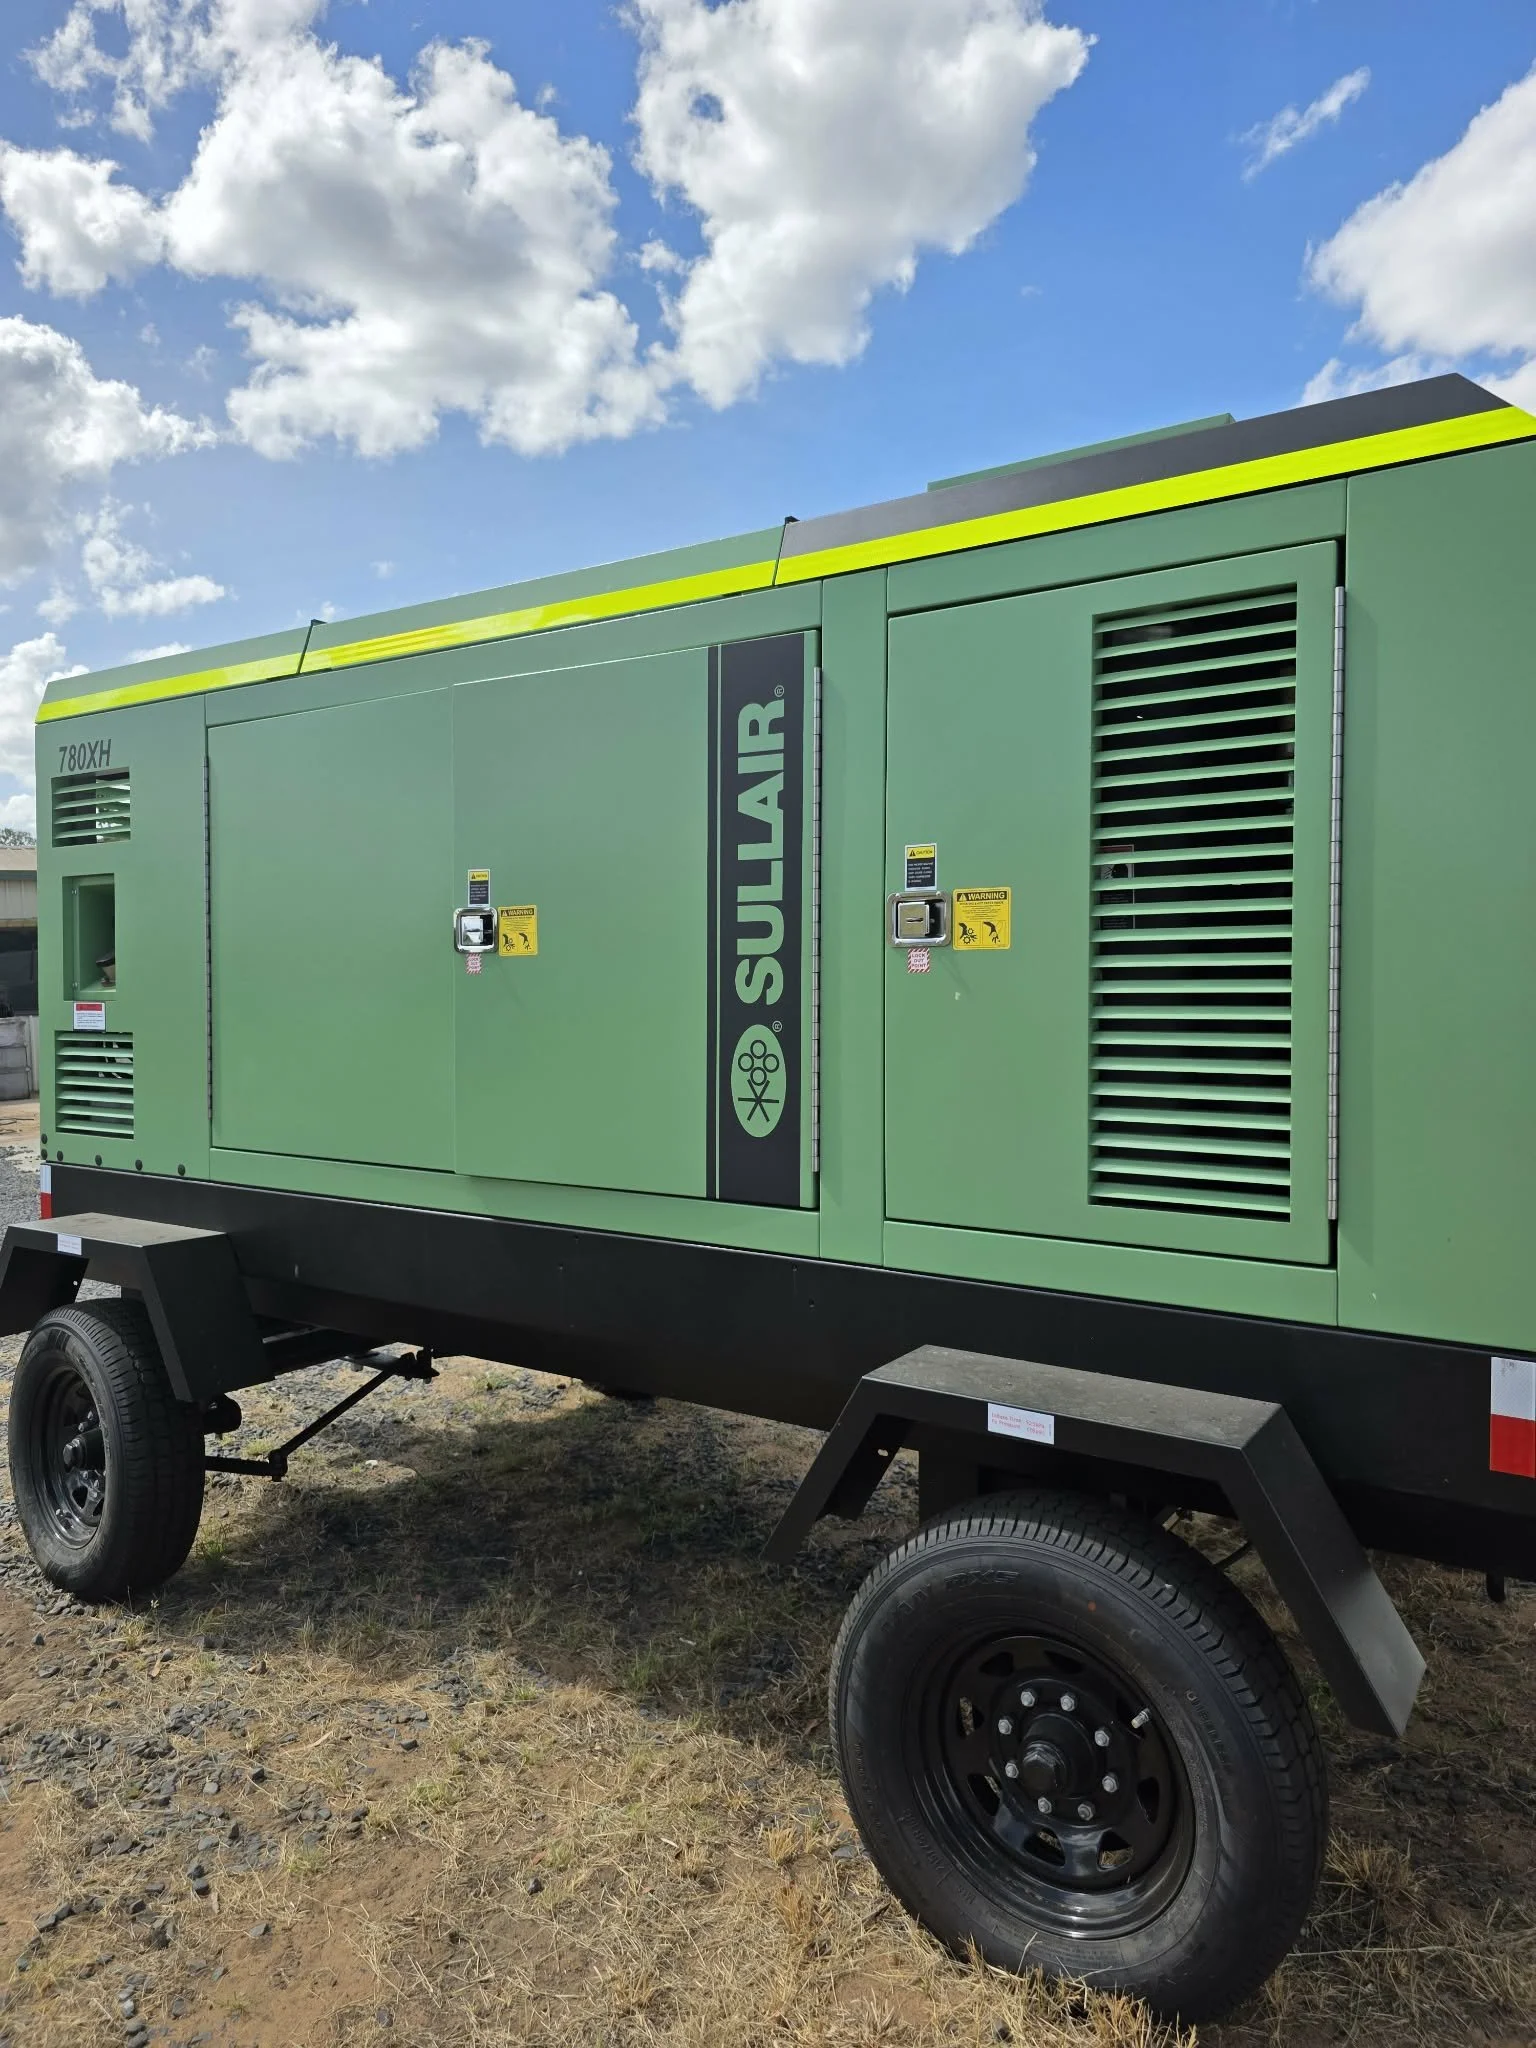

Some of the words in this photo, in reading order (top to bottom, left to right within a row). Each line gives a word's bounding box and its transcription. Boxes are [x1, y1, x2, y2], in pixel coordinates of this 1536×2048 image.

[58, 738, 112, 773] 780XH
[735, 698, 785, 1006] SULLAIR
[968, 891, 1005, 901] WARNING
